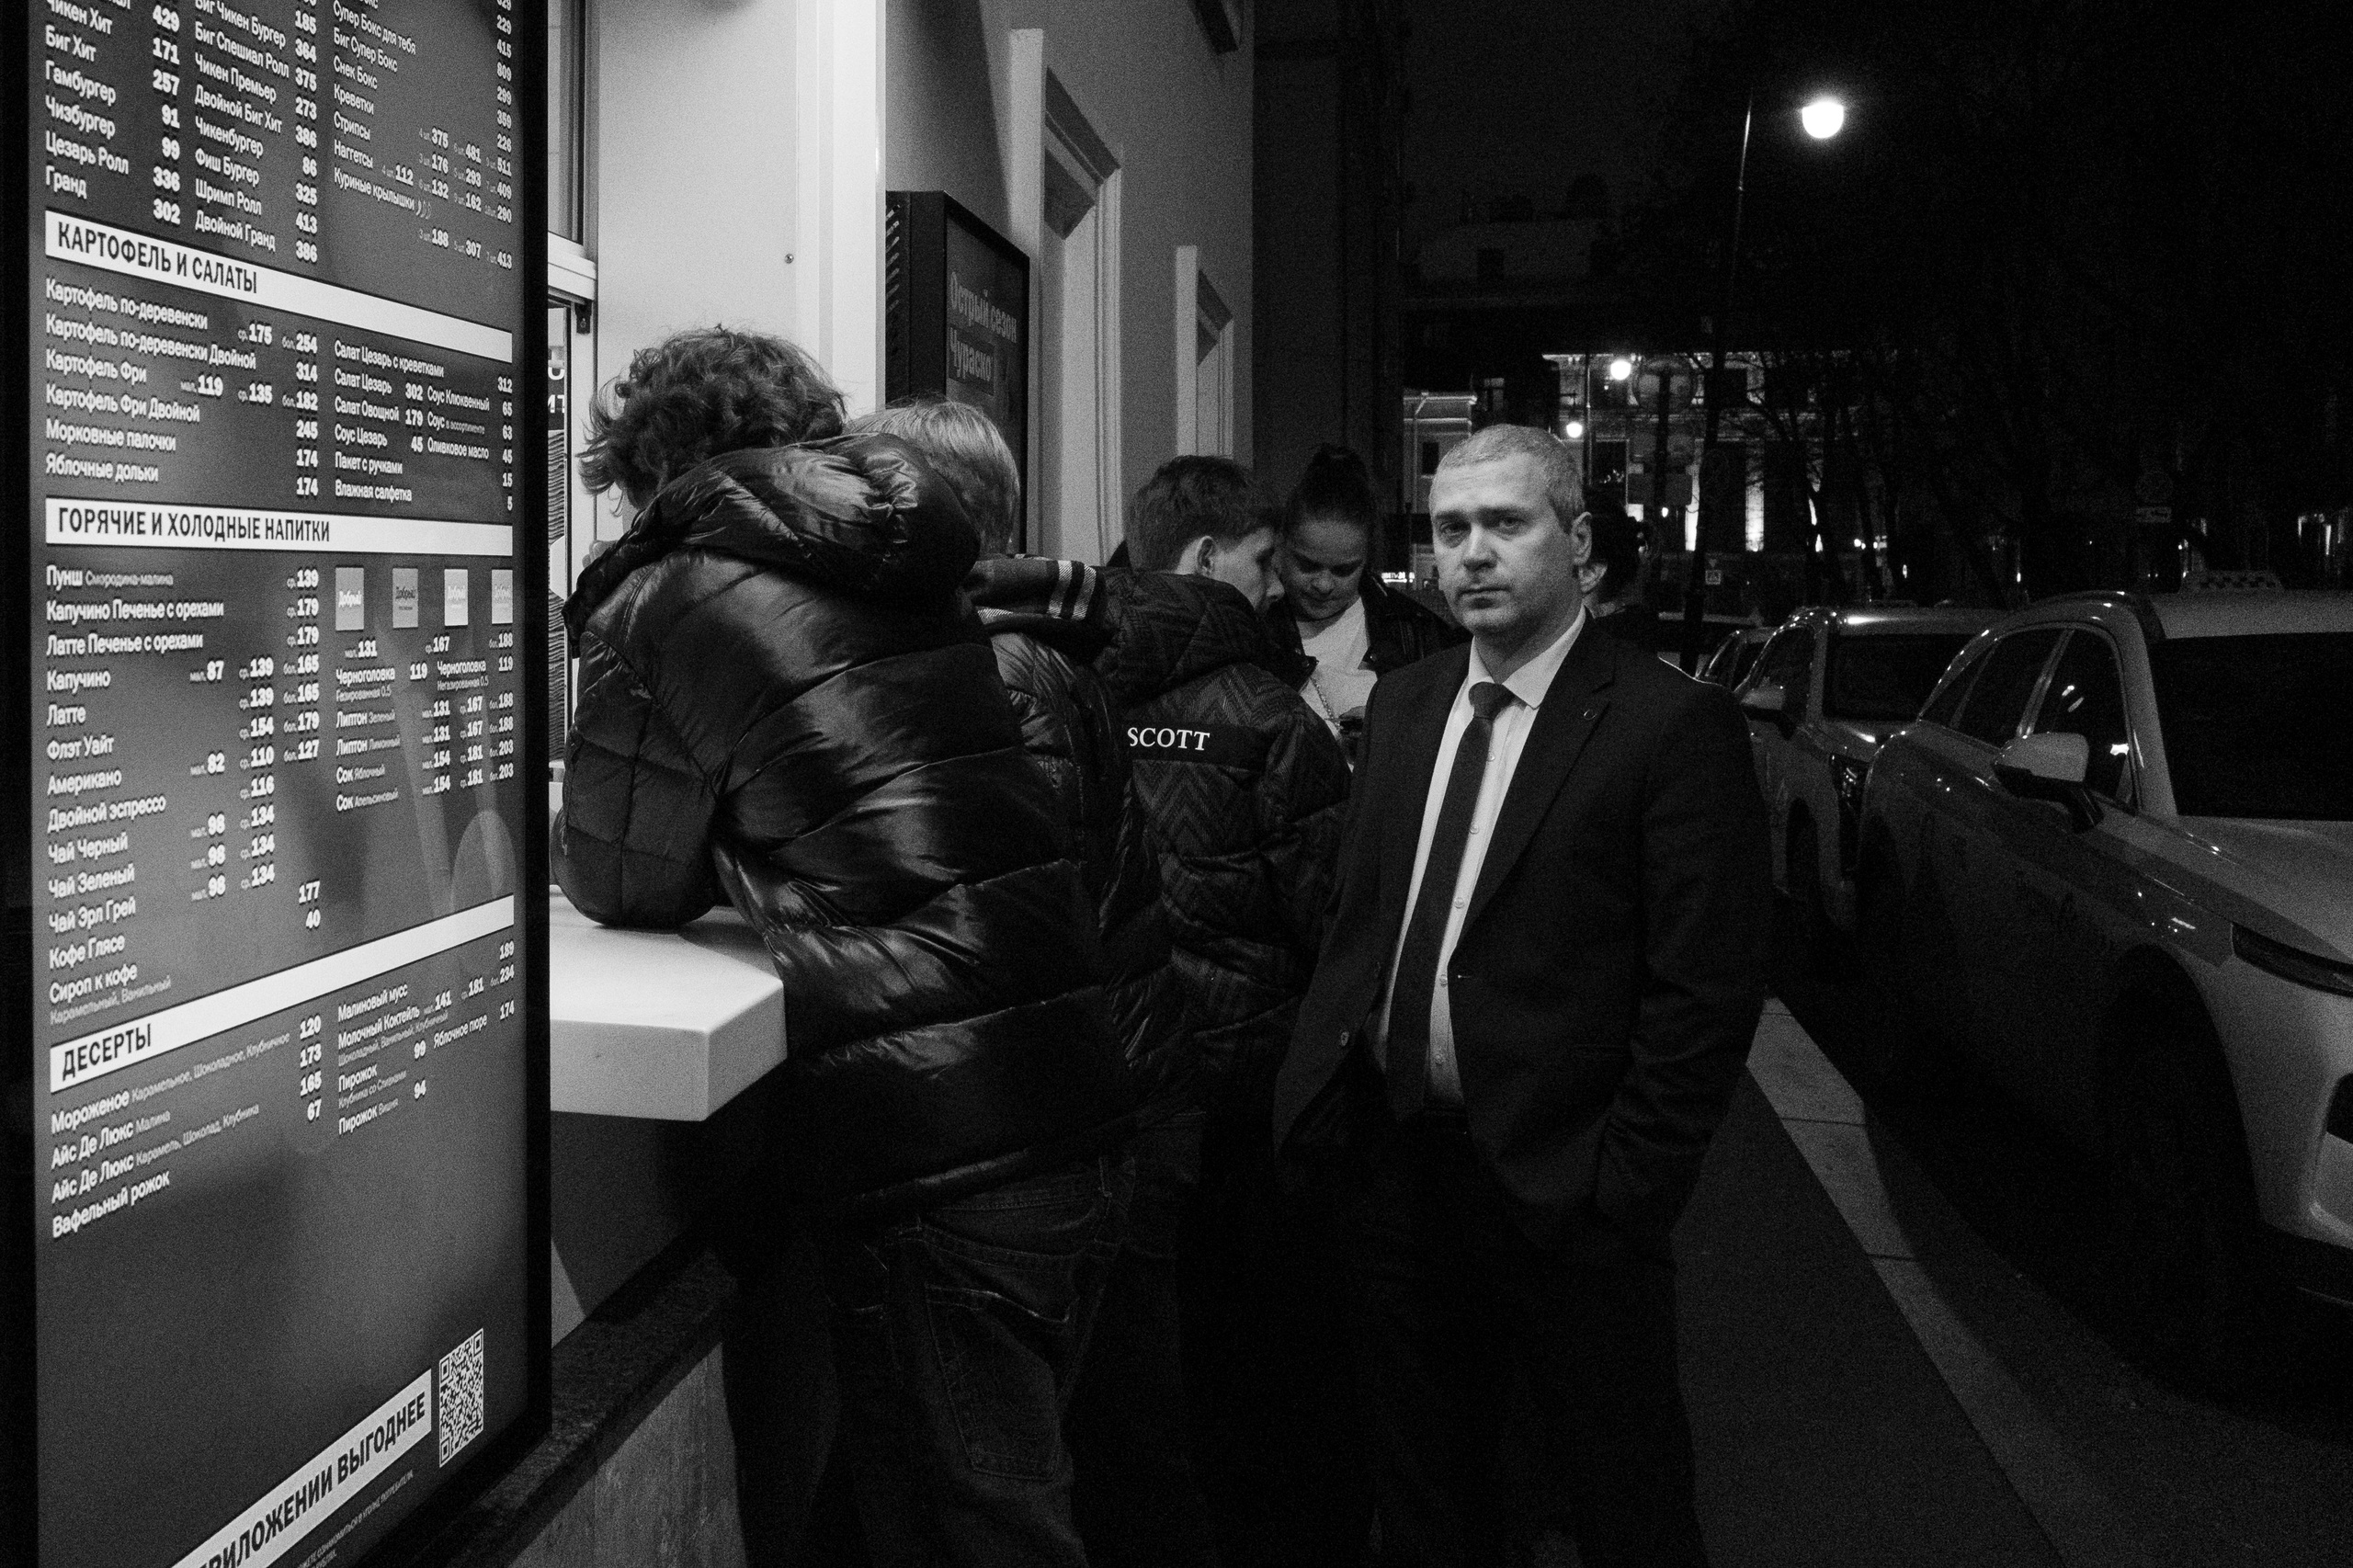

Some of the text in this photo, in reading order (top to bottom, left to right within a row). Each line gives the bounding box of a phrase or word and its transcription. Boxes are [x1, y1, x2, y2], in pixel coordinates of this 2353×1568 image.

[153, 5, 179, 31] 429
[333, 0, 359, 28] Супер
[360, 13, 381, 37] Бокс
[381, 28, 396, 45] для
[397, 35, 415, 54] тебя
[45, 24, 97, 62] Биг Хит
[195, 21, 289, 77] Биг Спешиал Ролл
[295, 38, 316, 62] 364
[333, 27, 397, 72] Биг Супер Бокс
[45, 60, 116, 106] Гамбургер
[195, 51, 277, 104] Чикен Премьер
[496, 62, 511, 81] 809
[194, 84, 282, 132] Двойной Биг Хит
[334, 84, 374, 114] Креветки
[45, 95, 115, 140] Чизбургер
[334, 111, 370, 140] Стрипсы
[162, 137, 180, 160] 99
[195, 116, 264, 159] Чикенбургер
[45, 131, 129, 174] Цезарь Ролл
[334, 139, 373, 168] Наггетсы
[431, 153, 449, 173] 176
[195, 148, 259, 187] Фиш Бургер
[301, 156, 317, 176] 86
[496, 157, 512, 176] 511
[45, 165, 86, 199] Гранд
[334, 167, 415, 210] Куриные крылышки
[195, 210, 276, 252] Двойной Гранд
[431, 228, 449, 247] 188
[58, 222, 256, 293] КАРТОФЕЛЬ И САЛАТЫ
[295, 240, 317, 262] 386
[46, 313, 256, 369] Картофель по-деревенски Двойной
[334, 339, 444, 377] Салат Цезарь с креветками
[198, 375, 223, 396] 119
[248, 383, 272, 403] 135
[426, 385, 489, 410] Соус Клюквенный
[497, 376, 512, 393] 312
[46, 383, 199, 421] Картофель Фри Двойной
[334, 395, 399, 421] Салат Овощной
[426, 411, 445, 430] Соус
[46, 418, 176, 450] Морковные палочки
[334, 423, 387, 449] Соус Цезарь
[426, 437, 489, 459] Оливковое масло
[502, 449, 512, 463] 45
[45, 453, 158, 482] Яблочные дольки
[335, 450, 403, 475] Пакет с ручками
[296, 477, 318, 495] 174
[335, 479, 412, 503] Влажная салфетка
[59, 506, 329, 541] ГОРЯЧИЕ И ХОЛОДНЫЕ НАПИТКИ
[46, 564, 83, 590] Пунш
[46, 598, 224, 625] Капучино Печенье с орехами
[297, 626, 319, 644] 179
[432, 636, 449, 652] 167
[358, 640, 378, 657] 131
[498, 655, 513, 671] 119
[47, 670, 111, 693] Капучино
[335, 667, 395, 687] Черноголовка
[297, 683, 319, 701] 165
[46, 704, 85, 725] Латте
[335, 710, 367, 728] Липтон
[47, 734, 114, 759] Флэт Уайт
[432, 725, 450, 742] 131
[1127, 727, 1211, 751] SCOTT
[250, 745, 274, 767] 110
[467, 744, 483, 761] 181
[498, 739, 513, 756] 203
[47, 769, 122, 795] Американо
[335, 767, 353, 783] Сок
[47, 796, 166, 833] Двойной эспрессо
[48, 832, 128, 863] Чай Черный
[208, 845, 225, 865] 98
[251, 834, 275, 856] 134
[49, 896, 136, 932] Чай Эрл Грей
[305, 909, 321, 928] 40
[49, 935, 125, 968] Кофе Глясе
[49, 963, 137, 1003] Сироп к кофе
[337, 983, 407, 1021] Малиновый мусс
[435, 990, 451, 1010] 141
[499, 1000, 514, 1019] 174
[337, 1006, 420, 1049] Молочный Коктейль
[433, 1015, 487, 1048] Яблочное пюре
[63, 1023, 151, 1081] ДЕСЕРТЫ
[338, 1064, 377, 1092] Пирожок
[307, 1098, 322, 1119] 67
[338, 1105, 377, 1134] Пирожок
[51, 1144, 76, 1168] Айс
[78, 1135, 97, 1160] Де
[98, 1121, 133, 1149] Люкс
[52, 1171, 170, 1237] Вафельный рожок
[337, 1392, 426, 1485] ВЫГОДНЕЕ
